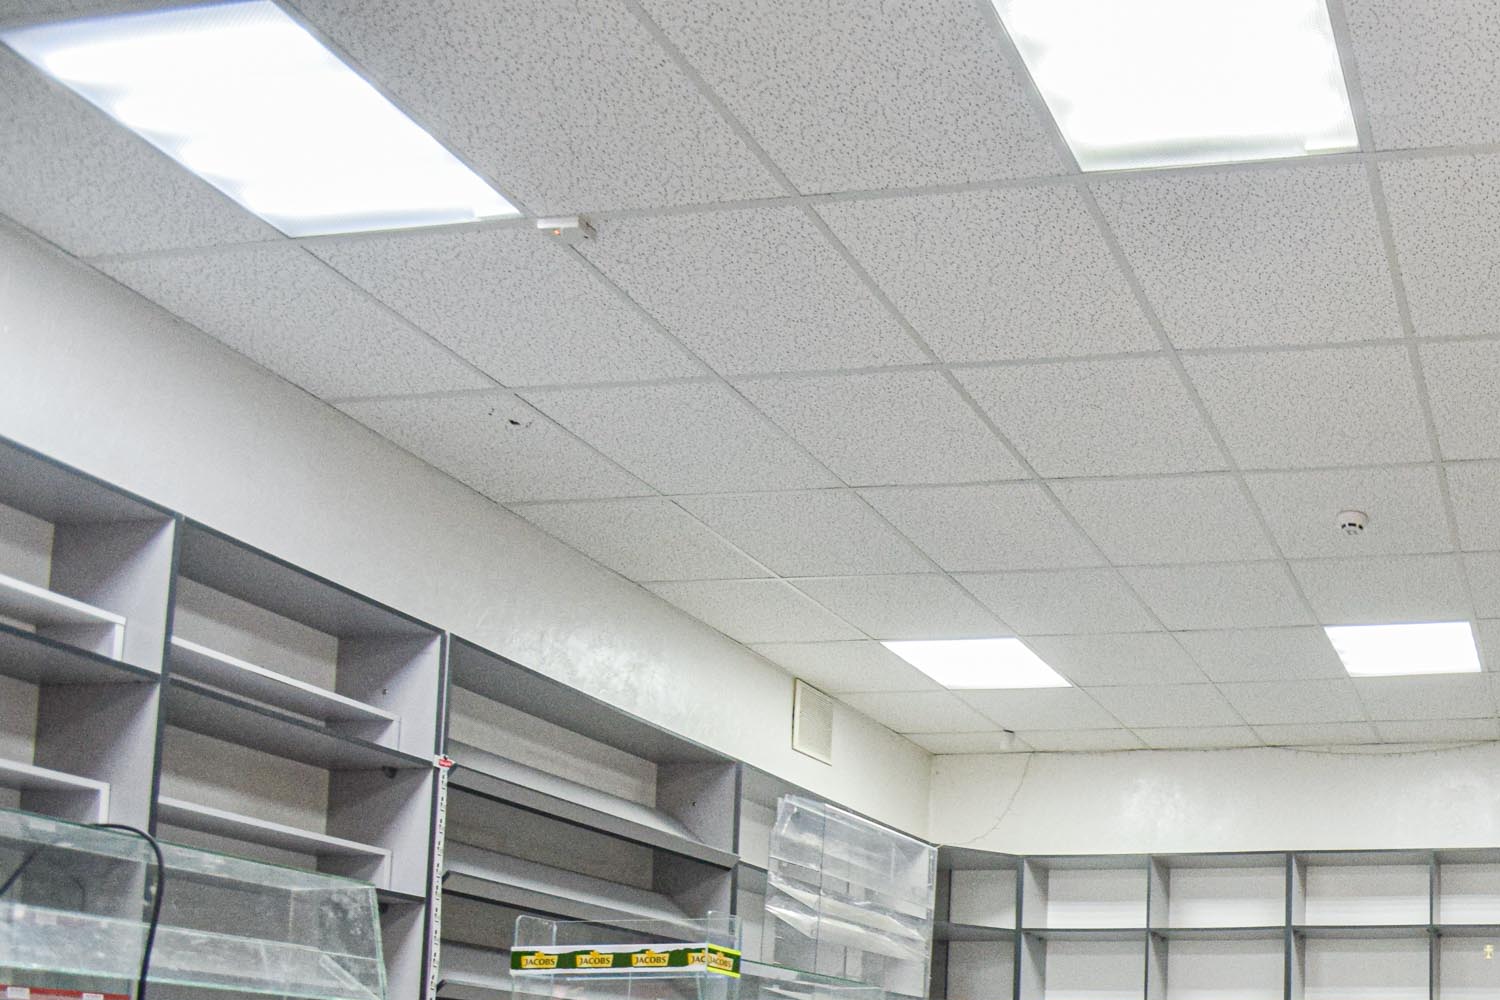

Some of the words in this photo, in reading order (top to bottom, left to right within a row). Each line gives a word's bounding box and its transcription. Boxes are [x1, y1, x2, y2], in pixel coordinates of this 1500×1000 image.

[525, 957, 555, 966] JACOBS
[580, 956, 610, 965] JACOBS
[635, 955, 666, 965] JACOBS
[709, 957, 731, 967] JACOBS
